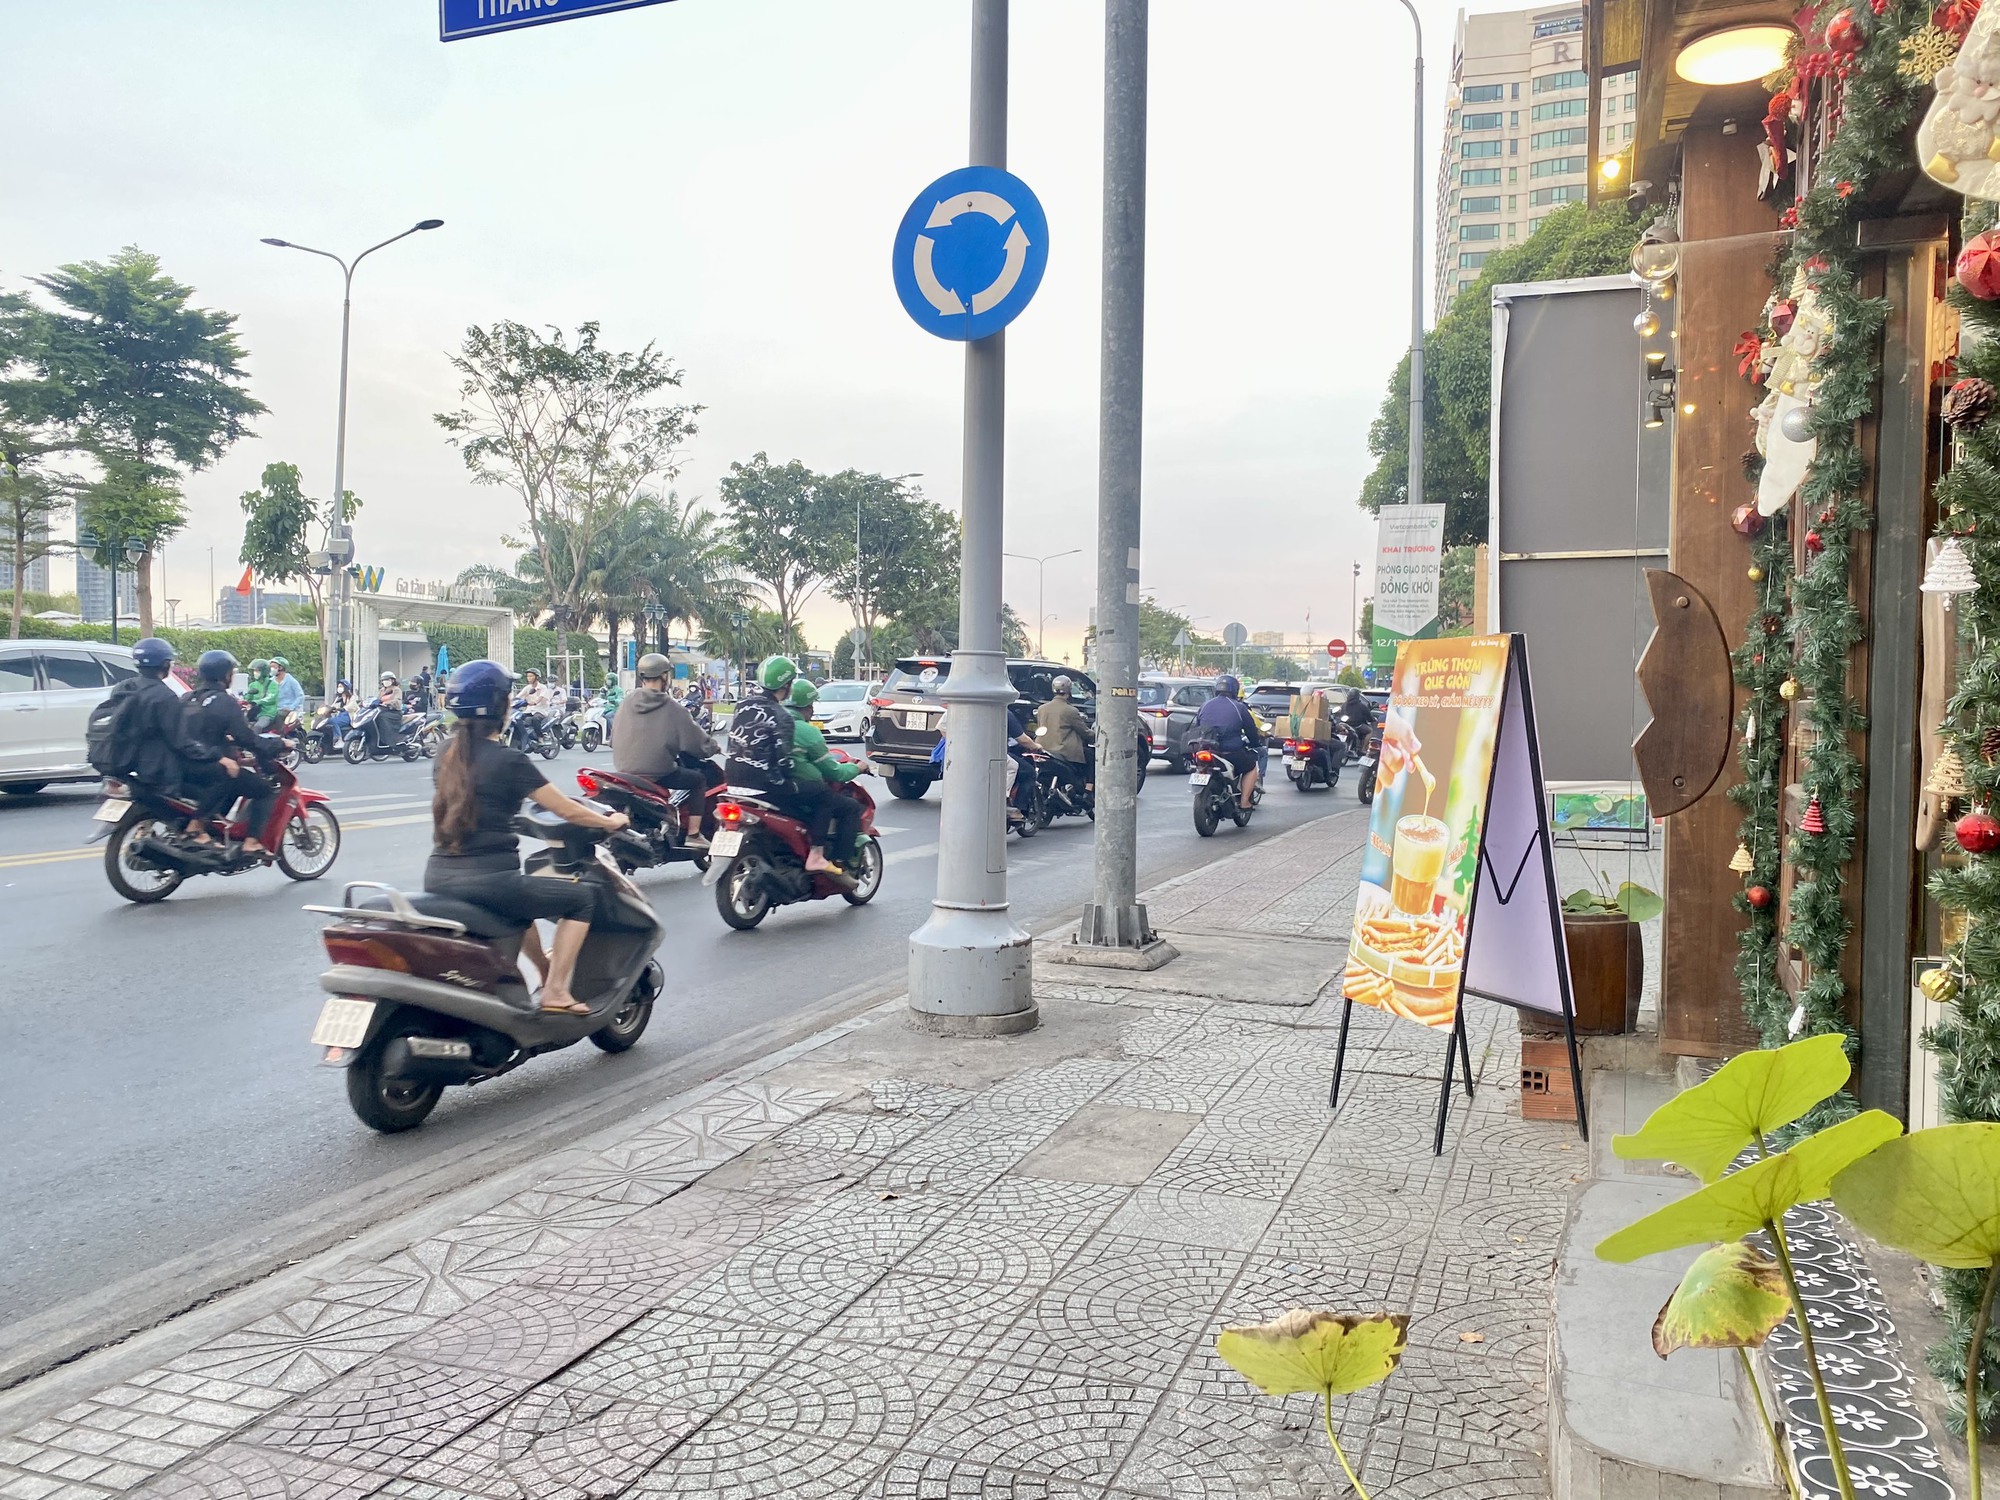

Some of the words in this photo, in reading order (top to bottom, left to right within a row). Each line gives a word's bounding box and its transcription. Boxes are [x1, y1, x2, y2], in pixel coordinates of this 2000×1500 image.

[1553, 41, 1574, 64] R
[1403, 564, 1420, 574] GIAO
[1421, 564, 1439, 576] DỊCH
[1415, 657, 1449, 676] TRỨNG
[1451, 657, 1482, 675] THƠM
[1424, 676, 1445, 691] QUE
[1446, 673, 1471, 690] GIÒN
